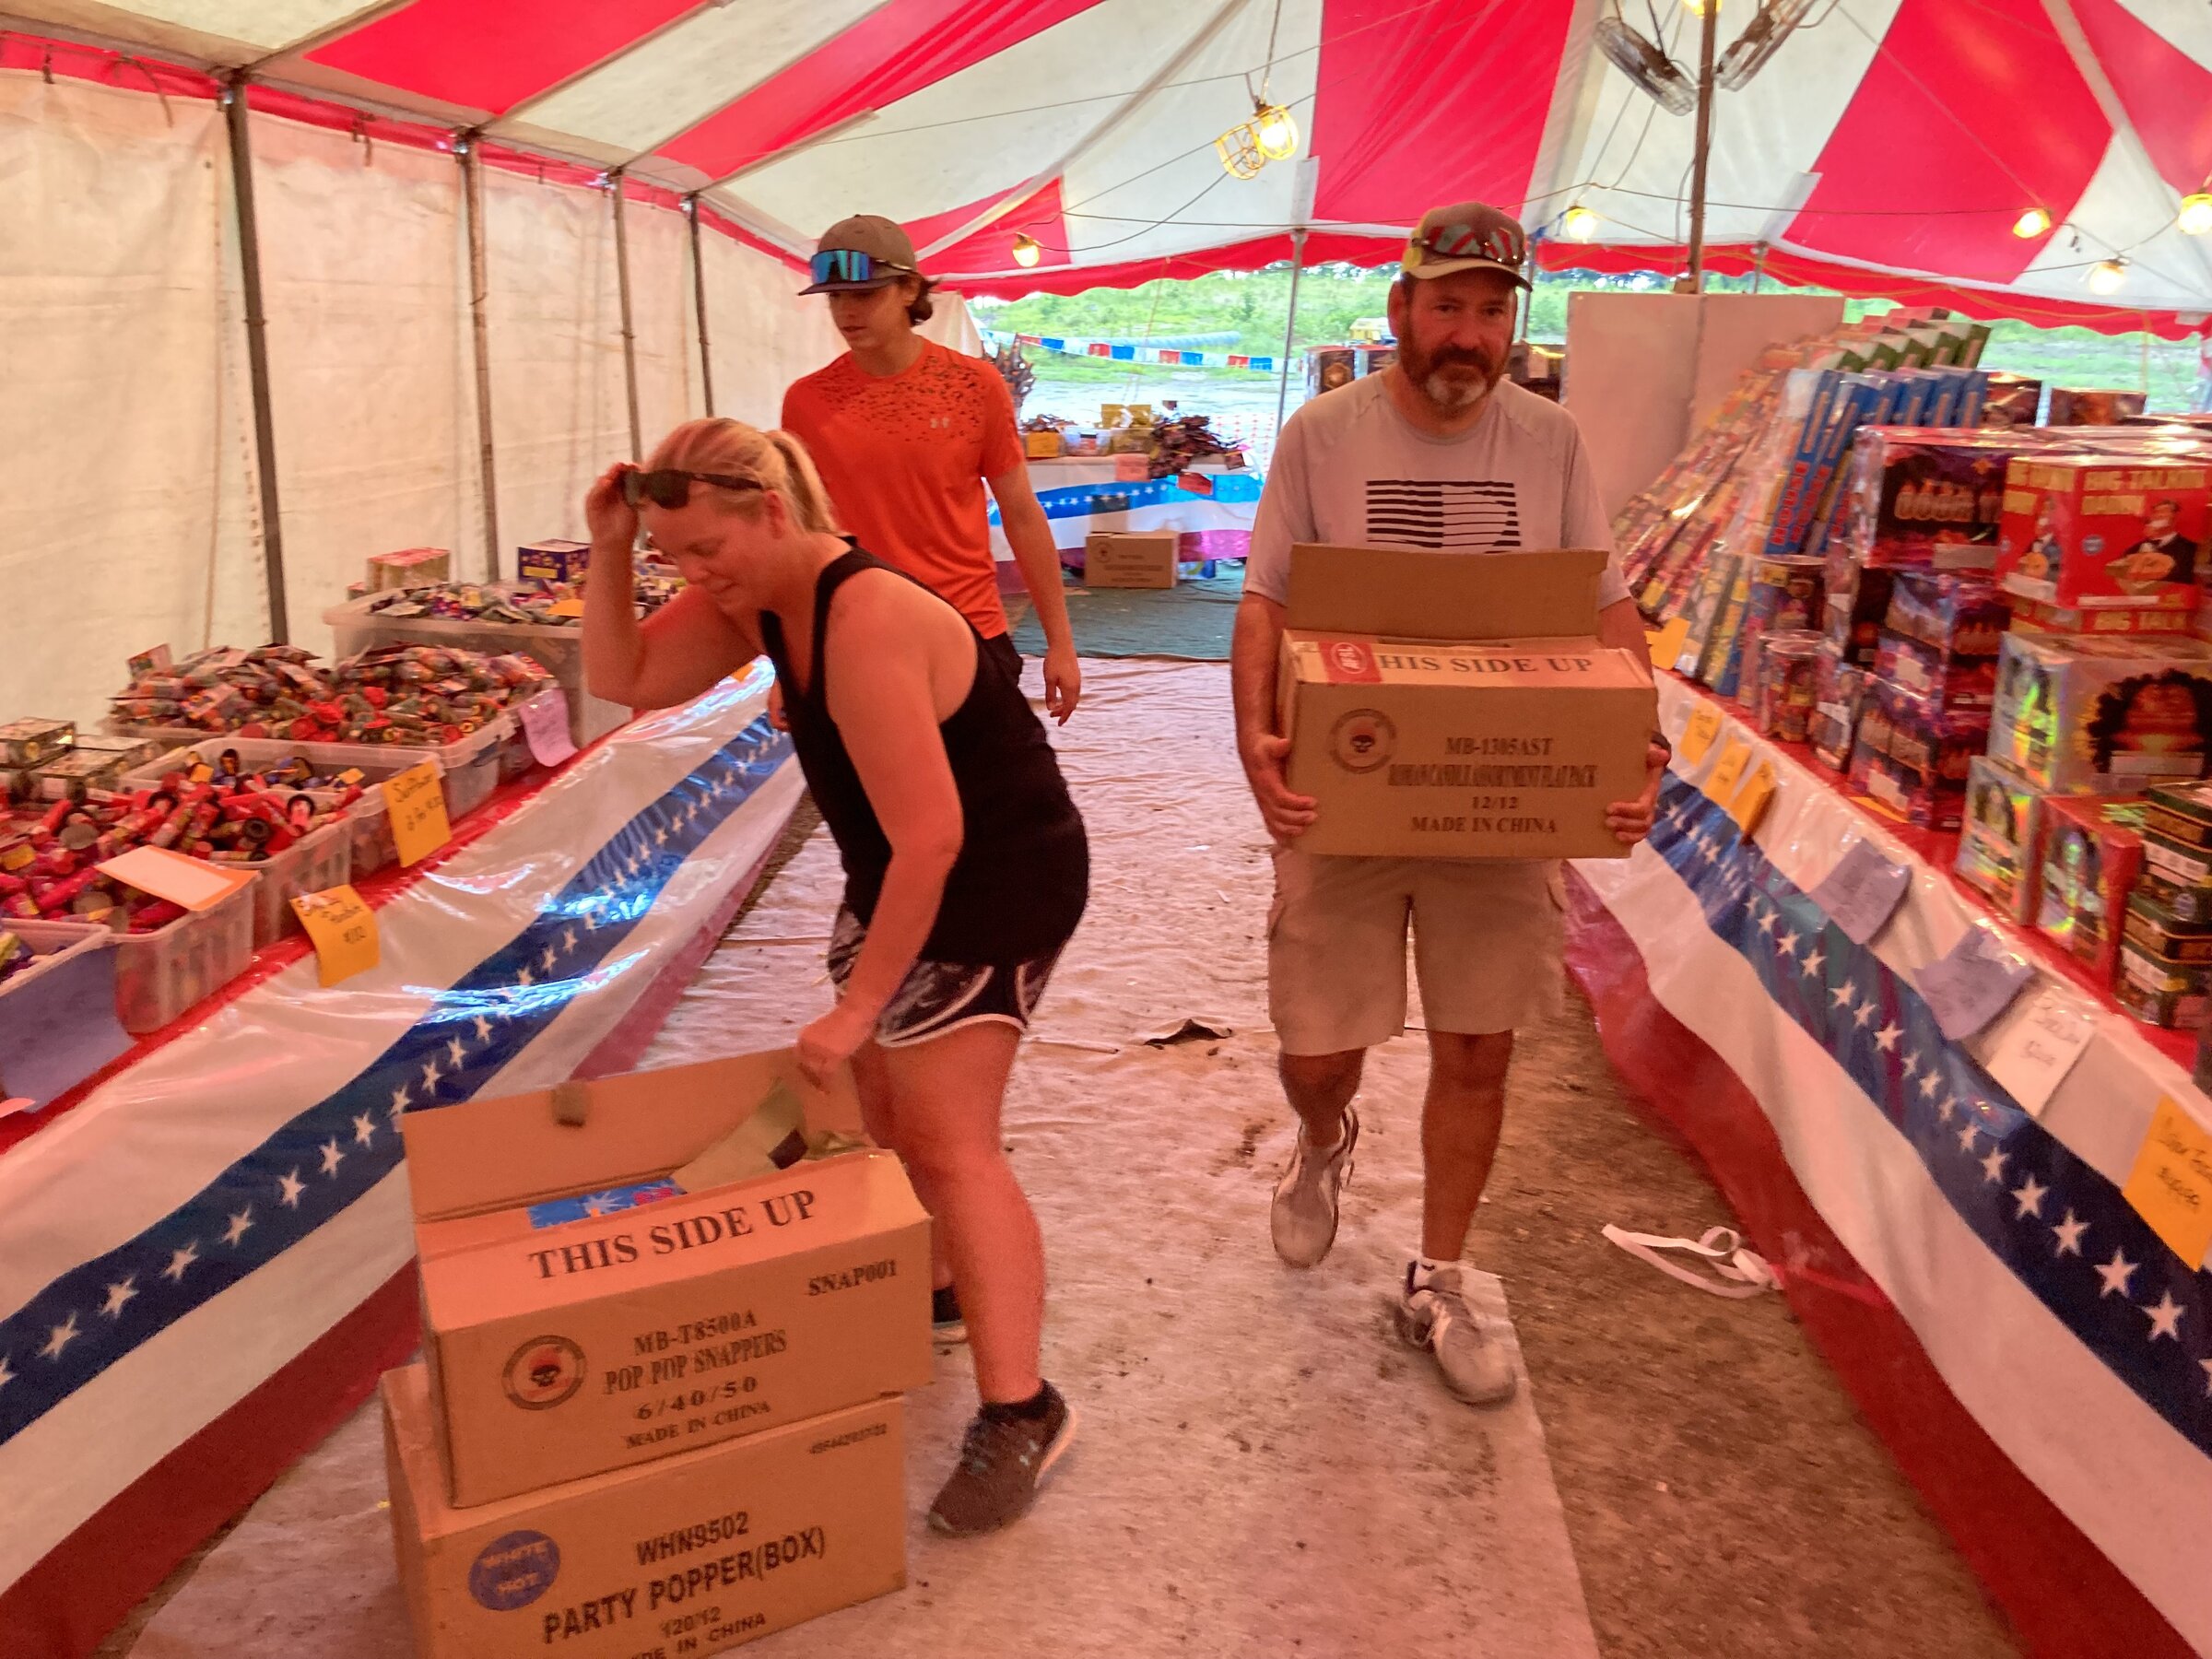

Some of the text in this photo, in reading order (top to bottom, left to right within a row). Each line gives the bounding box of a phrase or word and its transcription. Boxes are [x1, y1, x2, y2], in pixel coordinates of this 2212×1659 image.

[1379, 654, 1441, 671] HIS
[1450, 657, 1538, 674] SIDE
[1547, 657, 1594, 673] UP
[1411, 816, 1558, 833] MADE IN CHINA
[1472, 796, 1520, 809] 12/12
[528, 1189, 816, 1279] THIS SIDE UP
[806, 1258, 899, 1297] SNAP001
[604, 1328, 789, 1394] POP POP SNAPPERS
[625, 1400, 771, 1449] MADE IN CHINA
[634, 1511, 749, 1566] WHN9502
[543, 1524, 826, 1644] PARTY POPPER(BOX)
[676, 1635, 698, 1654] IN
[708, 1611, 767, 1643] CHINA
